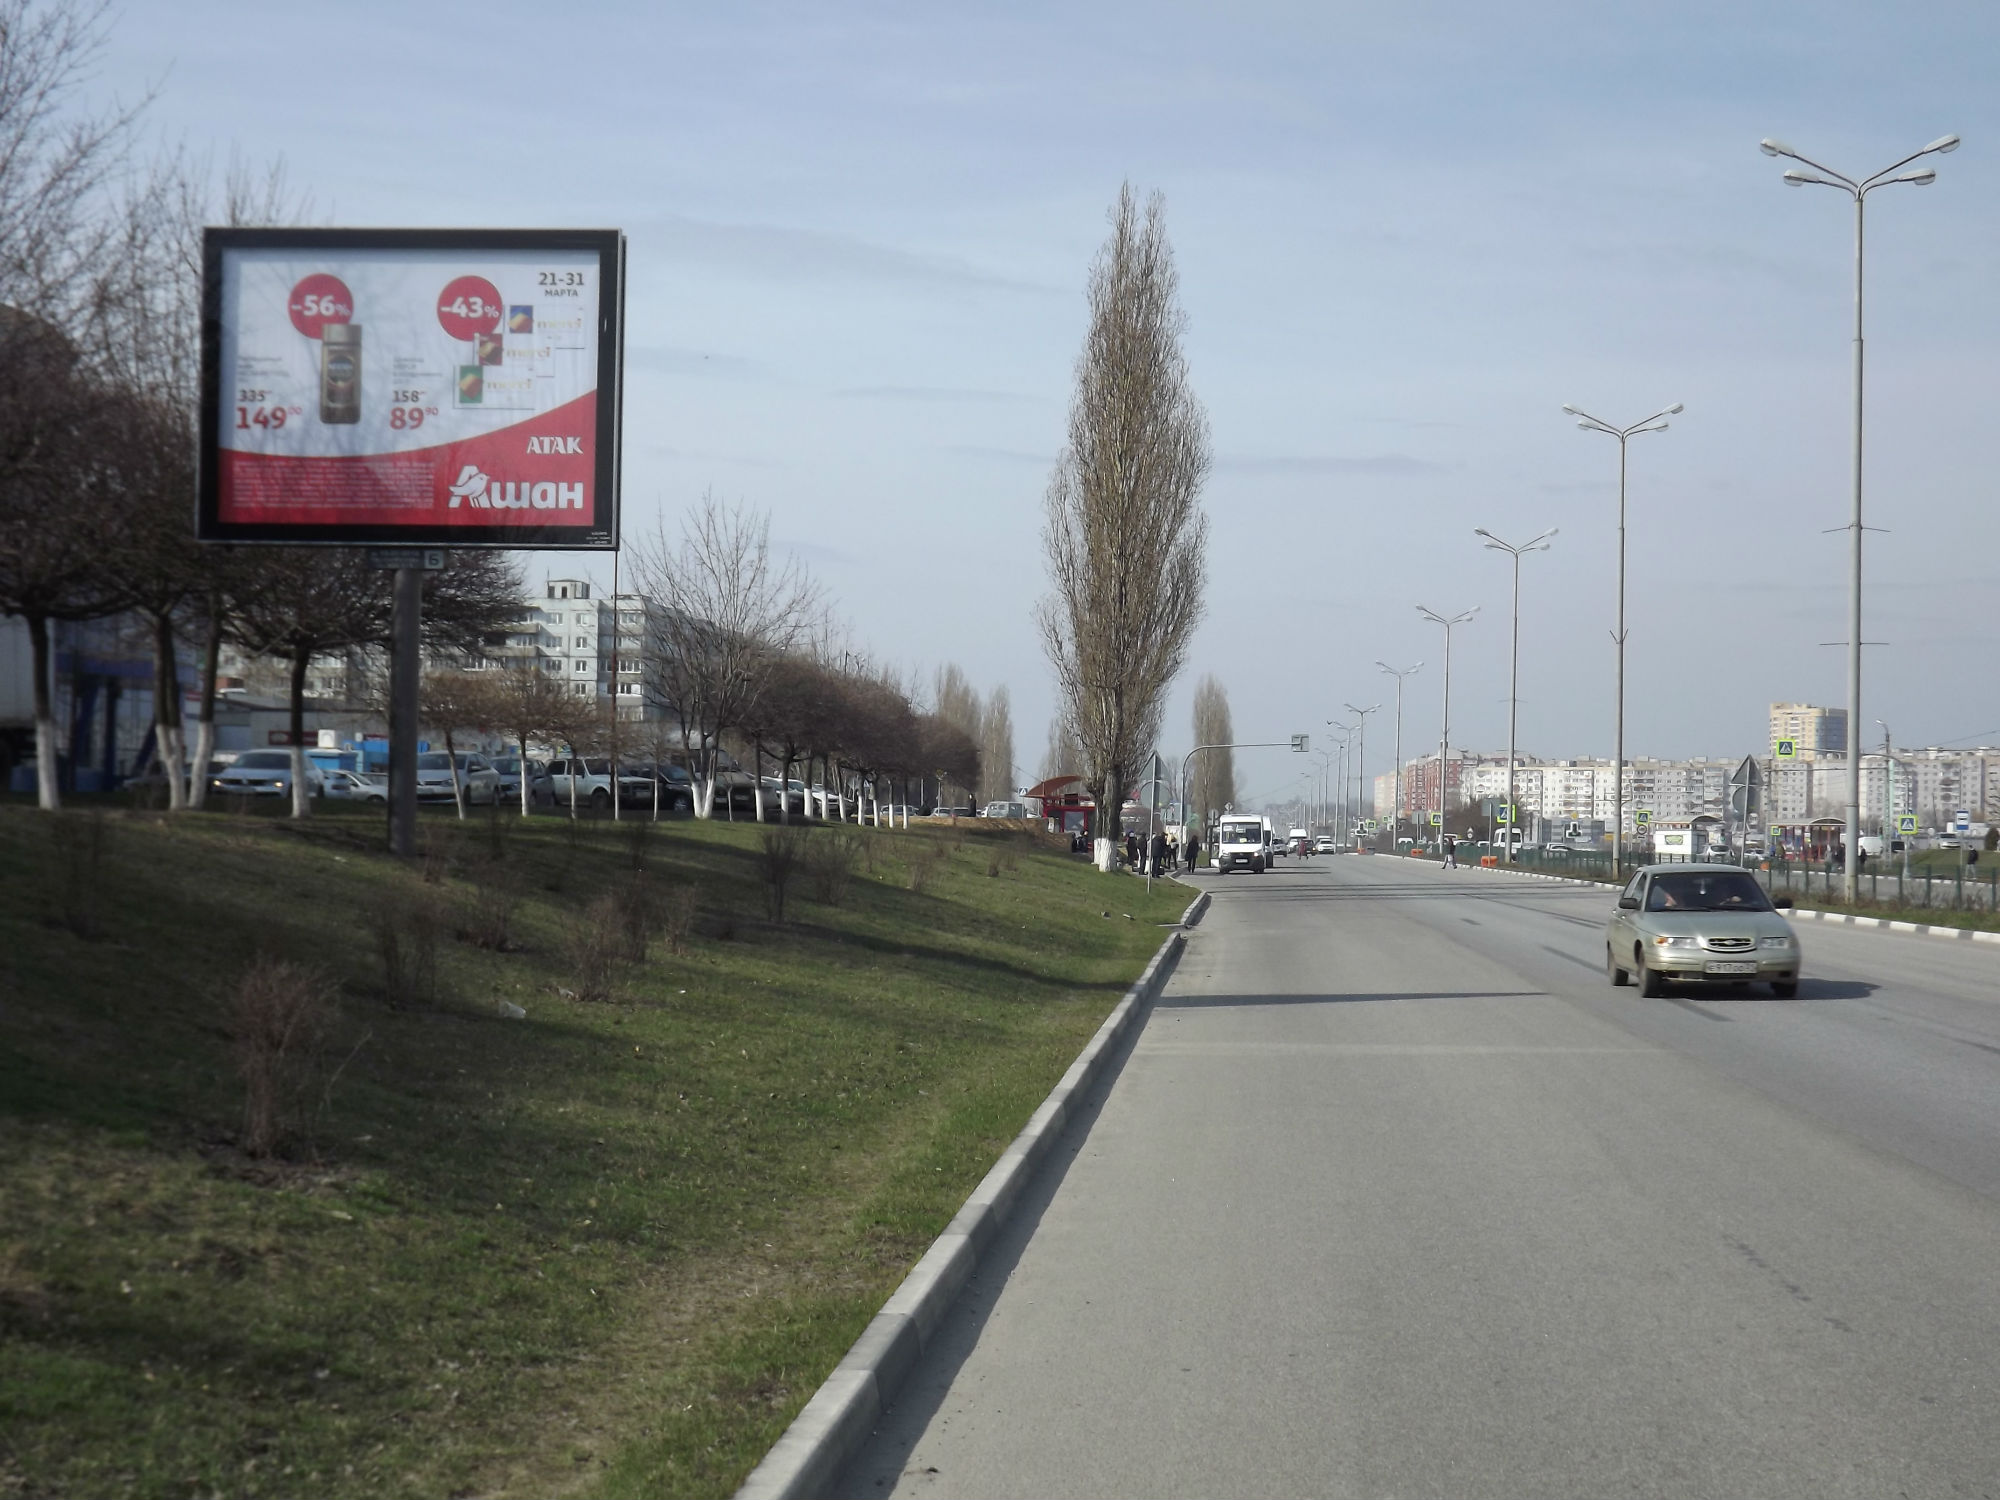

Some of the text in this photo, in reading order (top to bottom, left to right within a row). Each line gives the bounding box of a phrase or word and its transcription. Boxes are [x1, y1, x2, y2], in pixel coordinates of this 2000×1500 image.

[538, 272, 585, 286] 21-31
[544, 289, 579, 297] МАРТА
[526, 436, 584, 454] АТАК
